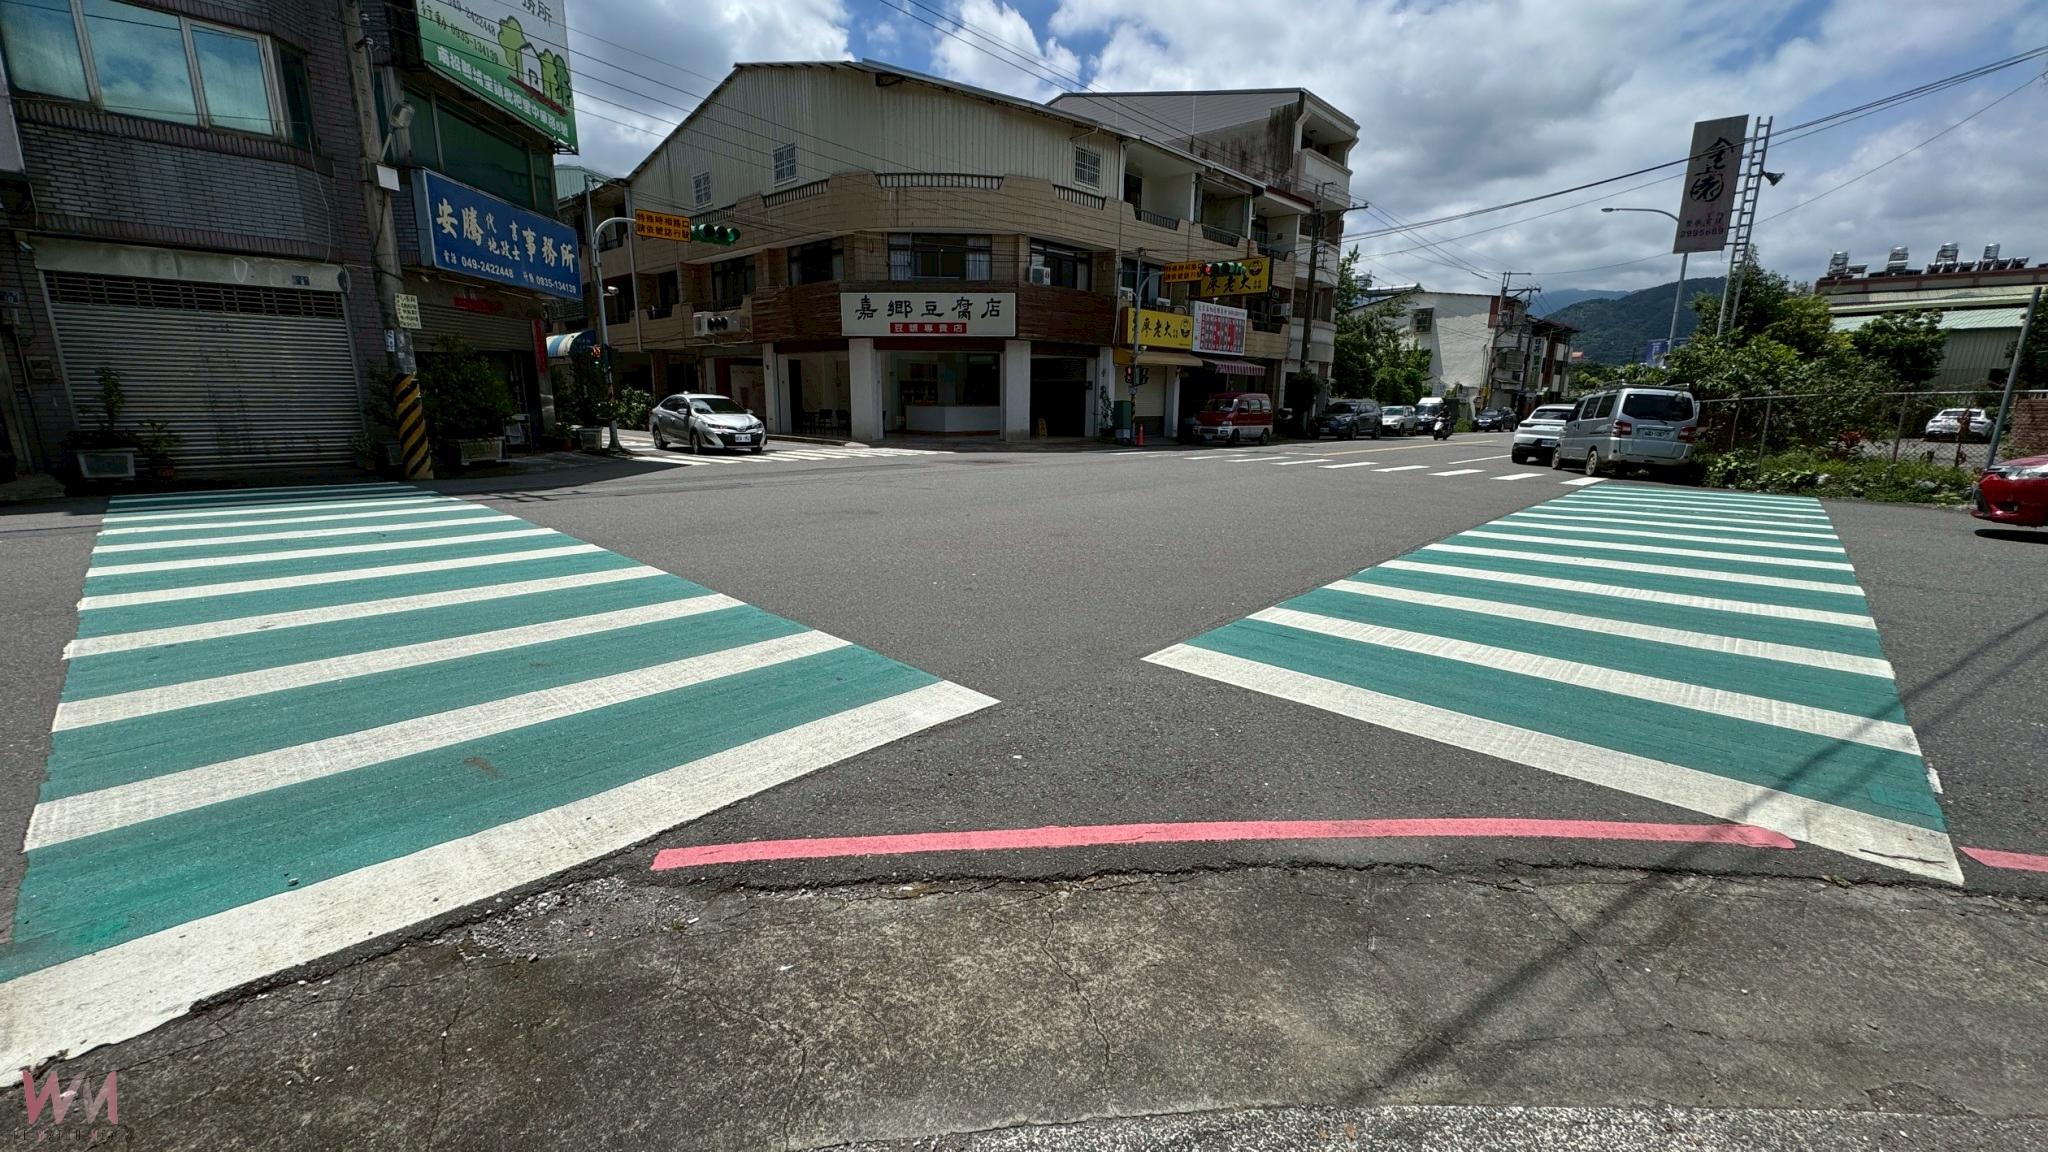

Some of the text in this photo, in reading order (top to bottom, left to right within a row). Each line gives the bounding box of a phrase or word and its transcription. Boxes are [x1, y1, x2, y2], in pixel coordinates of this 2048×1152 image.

[461, 256, 514, 279] 049-2422448
[536, 275, 577, 294] 0935-134139
[855, 294, 1002, 320] 嘉鄉豆腐店
[1141, 317, 1172, 338] 廖老大
